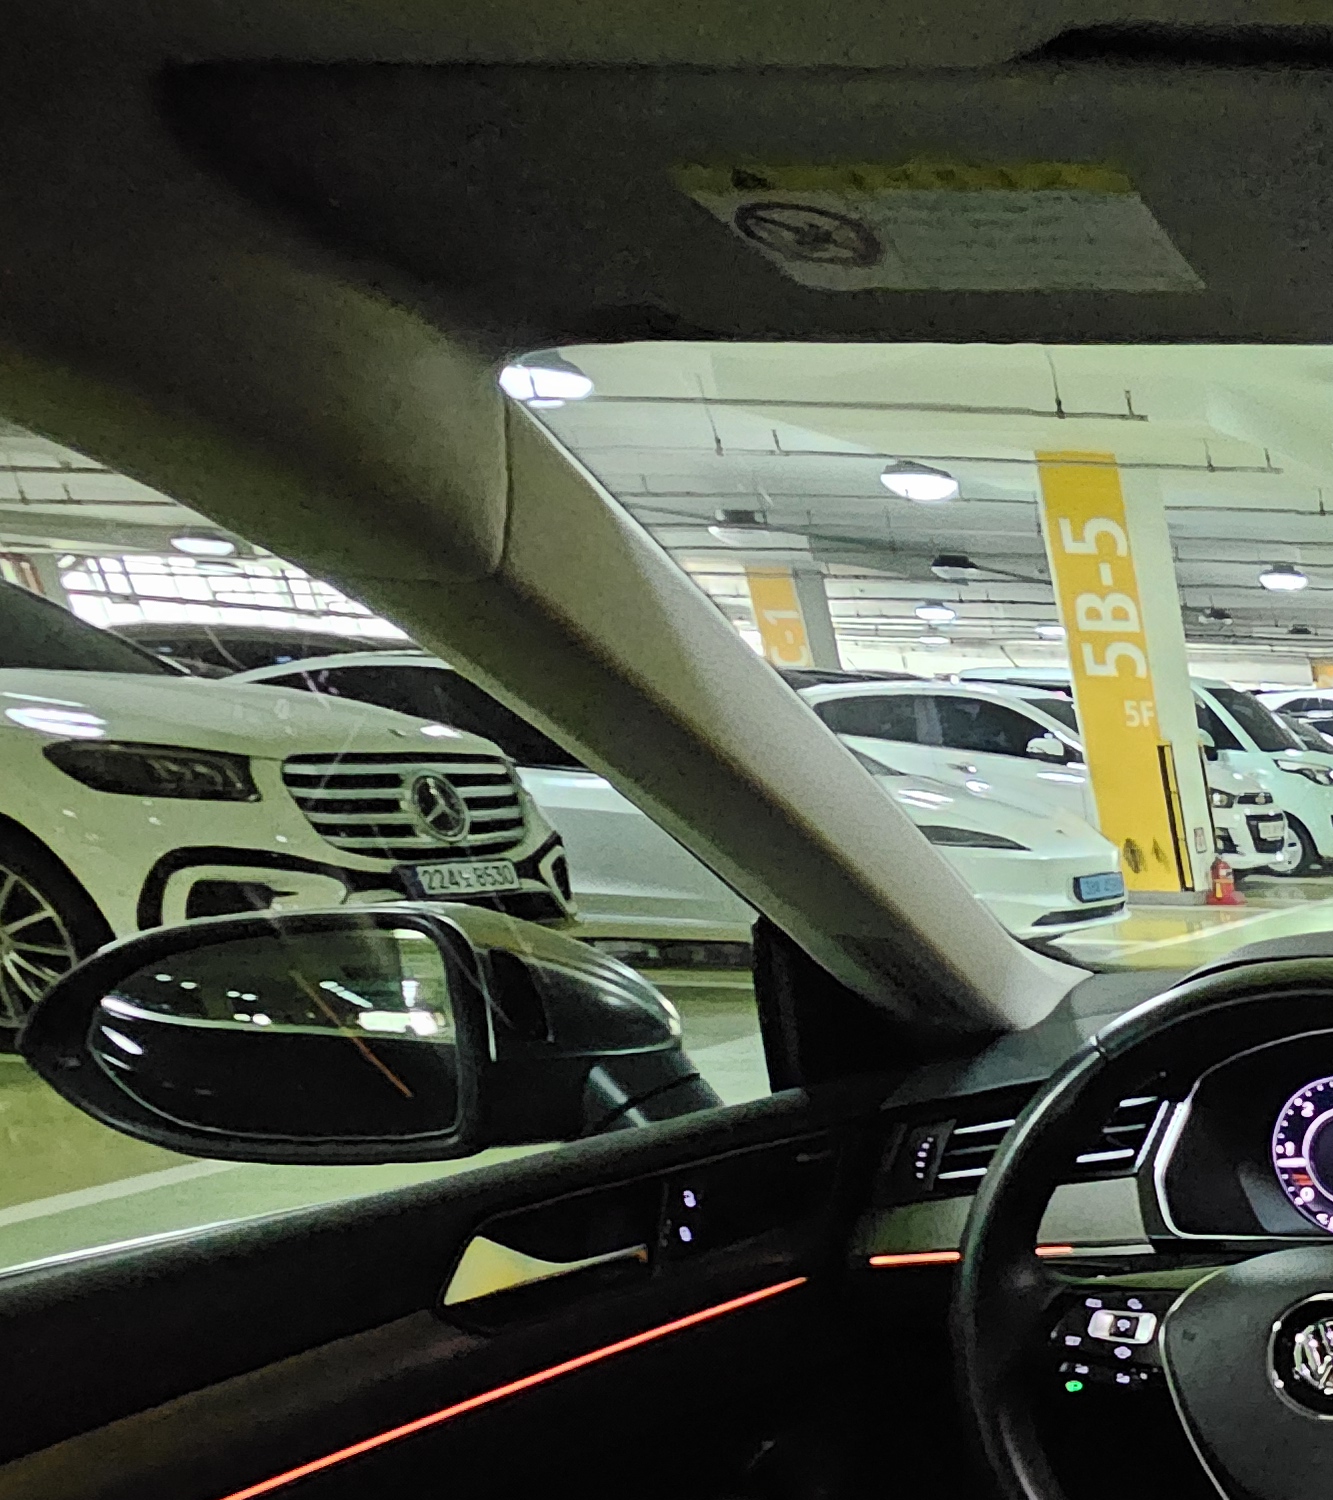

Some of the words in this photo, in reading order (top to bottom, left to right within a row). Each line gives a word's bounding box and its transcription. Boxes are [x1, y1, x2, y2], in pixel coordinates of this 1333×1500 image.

[1058, 516, 1148, 679] 5B-5
[762, 609, 811, 667] C-1
[1123, 699, 1155, 728] 5F
